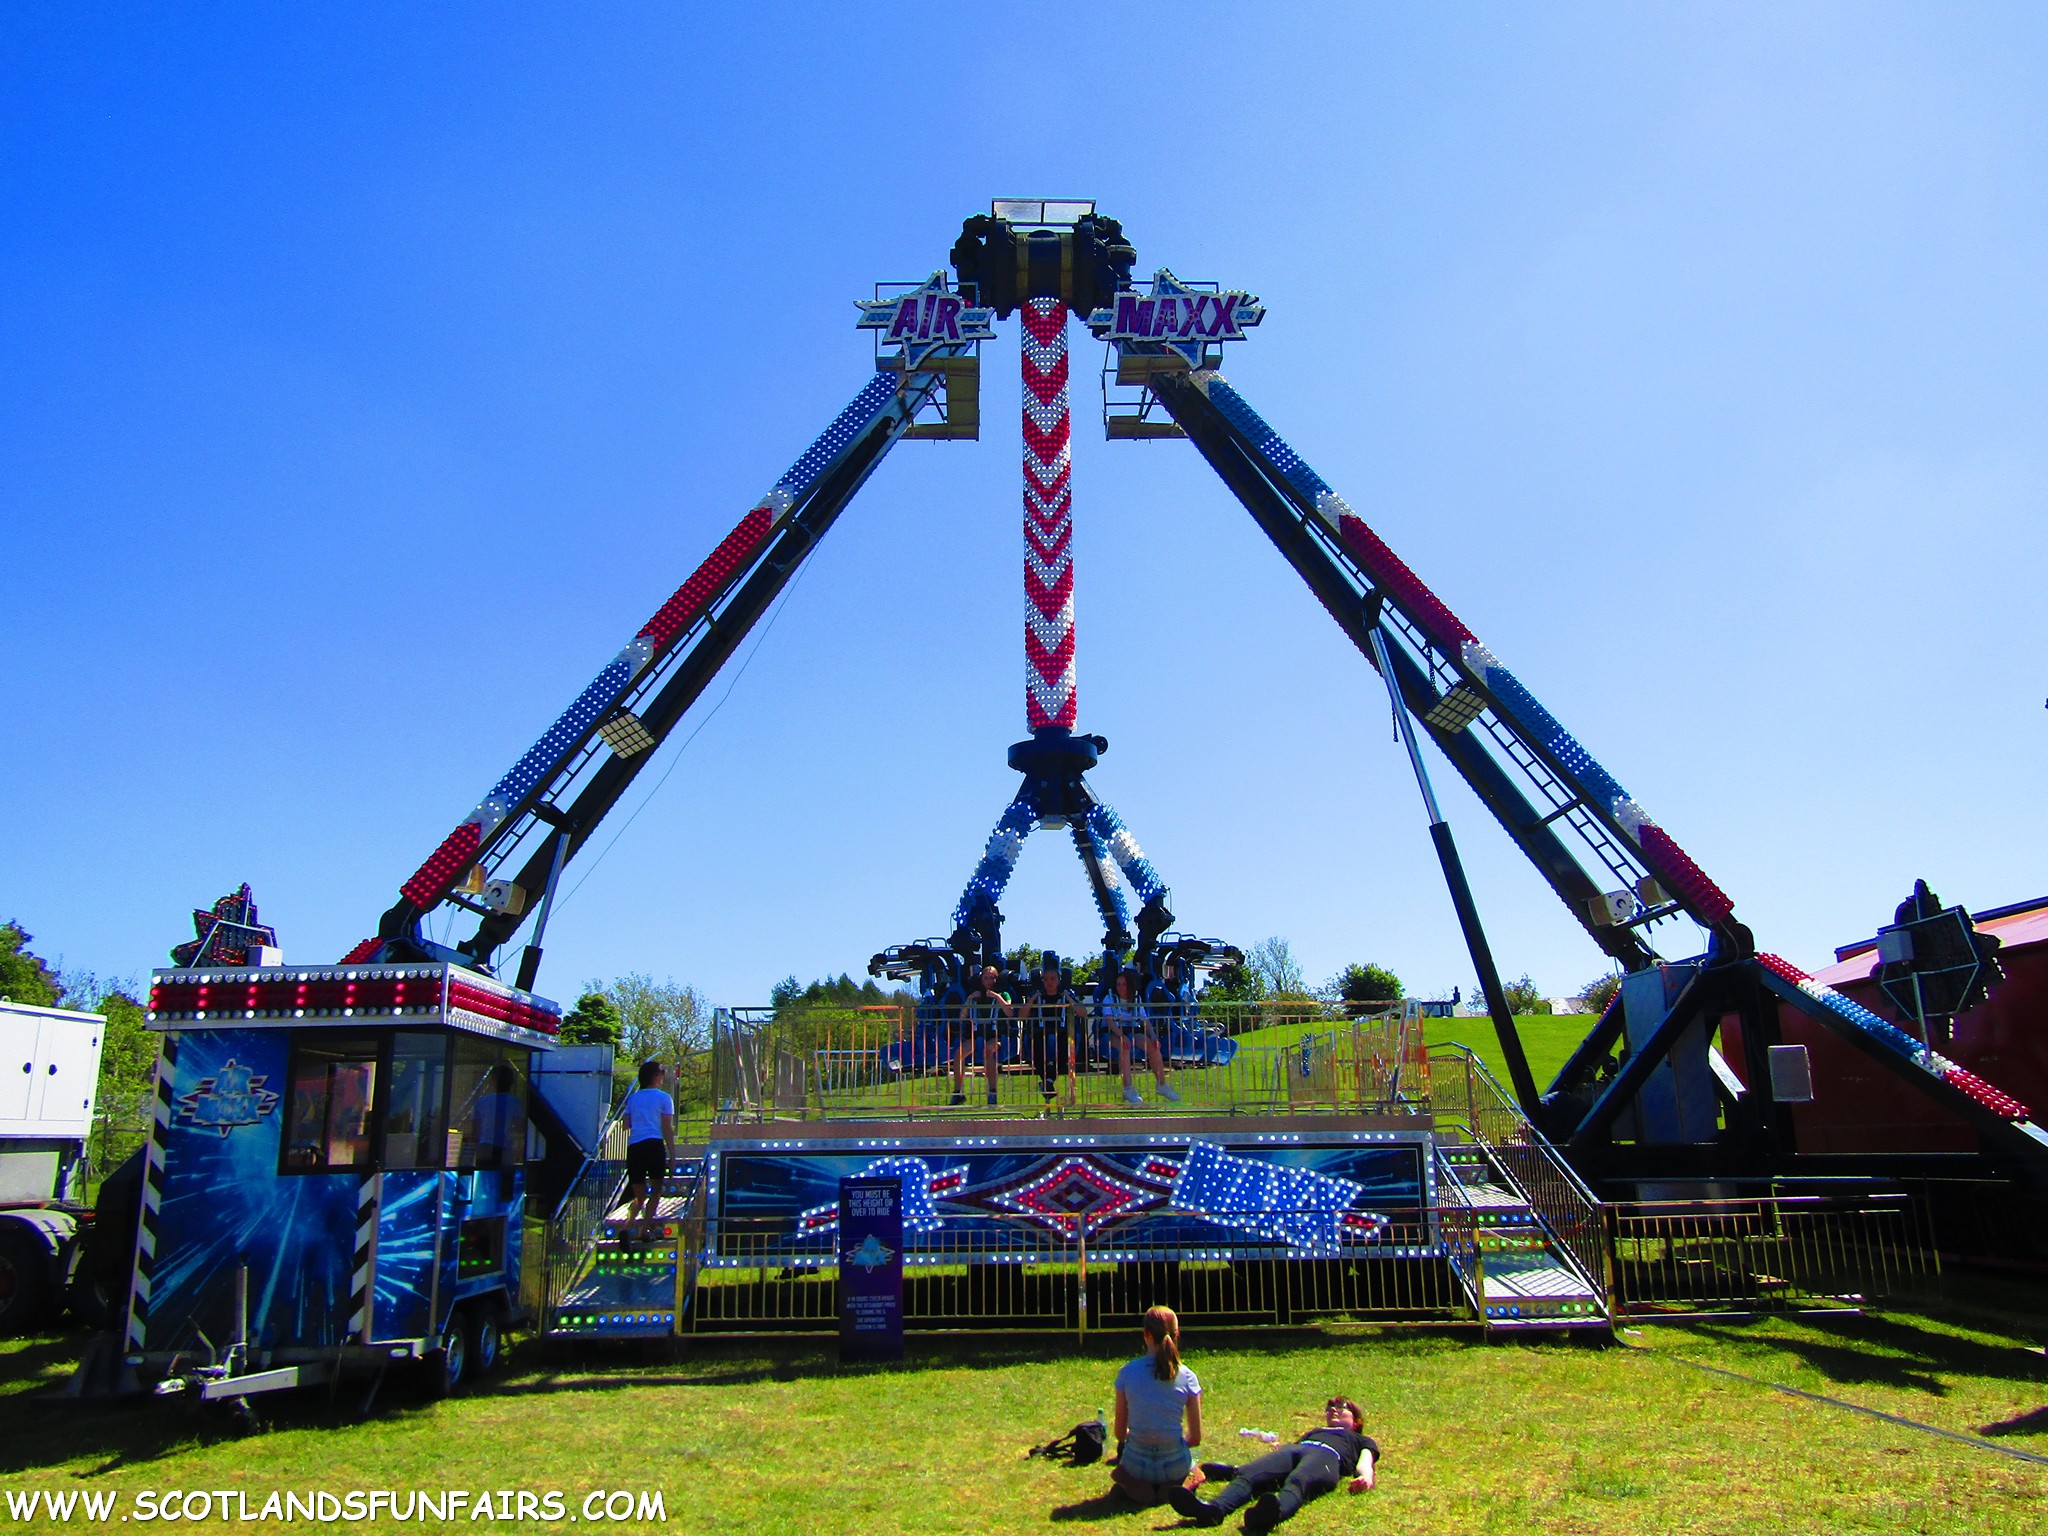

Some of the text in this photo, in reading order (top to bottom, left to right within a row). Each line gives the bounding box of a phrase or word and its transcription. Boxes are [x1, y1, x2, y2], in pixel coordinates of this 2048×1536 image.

[889, 293, 962, 341] AIR
[1115, 294, 1240, 338] MAXX
[851, 1189, 890, 1199] YOU MUST BE
[849, 1198, 893, 1208] THIS HEIGHT OR
[851, 1207, 890, 1217] OVER TO RIDE
